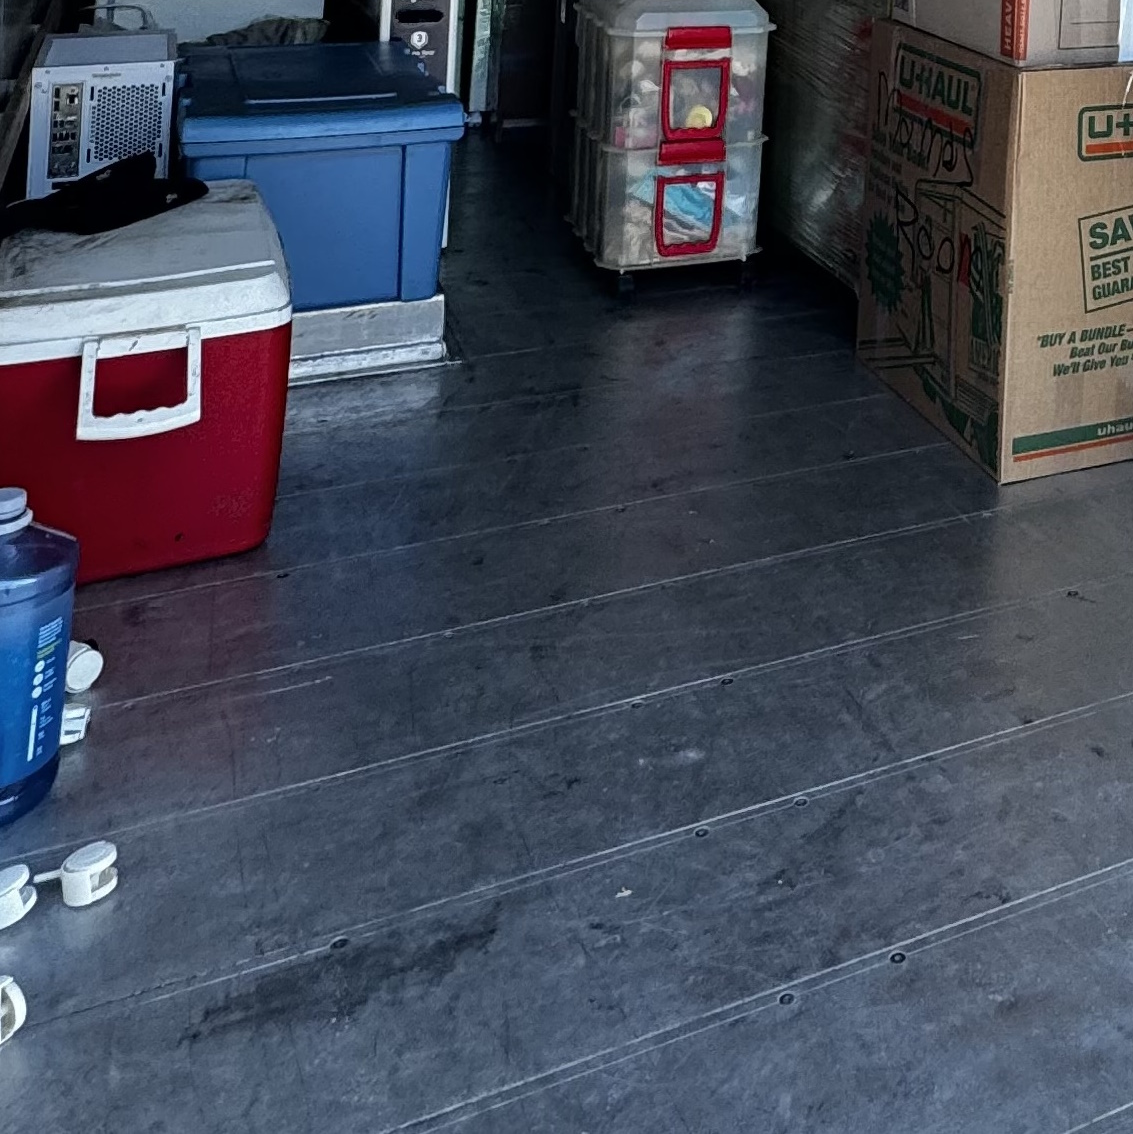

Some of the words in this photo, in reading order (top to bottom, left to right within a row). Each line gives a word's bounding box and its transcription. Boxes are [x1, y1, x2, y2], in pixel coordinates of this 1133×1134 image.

[1090, 255, 1130, 281] BEST
[1067, 331, 1077, 344] A
[1069, 346, 1095, 359] Beat
[1099, 342, 1118, 355] Our
[1053, 361, 1081, 377] We'll
[1082, 358, 1106, 372] Give
[1110, 355, 1129, 368] You
